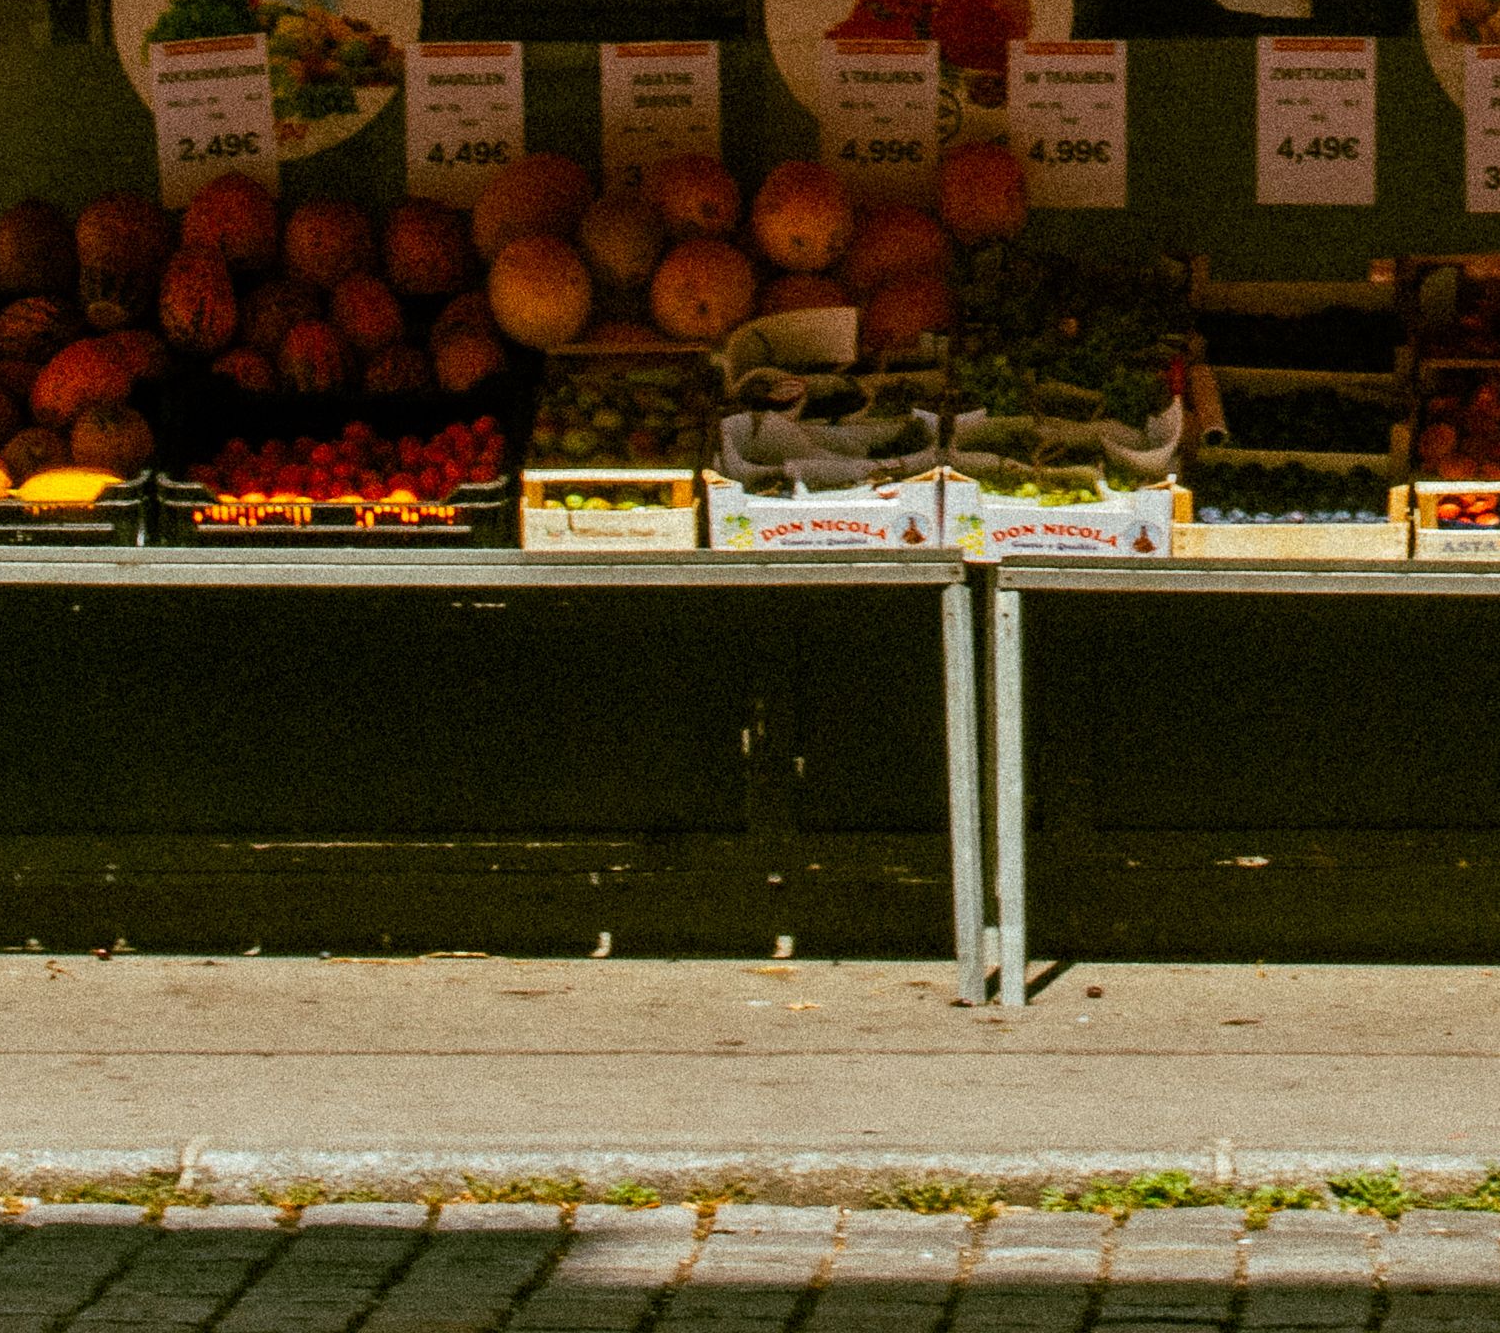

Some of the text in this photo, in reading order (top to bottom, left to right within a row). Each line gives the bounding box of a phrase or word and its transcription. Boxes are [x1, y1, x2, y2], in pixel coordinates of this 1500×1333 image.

[1044, 70, 1117, 85] TRAUBEN
[177, 130, 260, 164] 2,49€
[426, 140, 511, 167] 4,49€
[839, 139, 923, 165] 4,99€
[1028, 139, 1112, 165] 4,99€
[1276, 135, 1360, 163] 4,49€
[759, 519, 887, 542] DON NICOLA
[991, 523, 1118, 548] DON NICOLA
